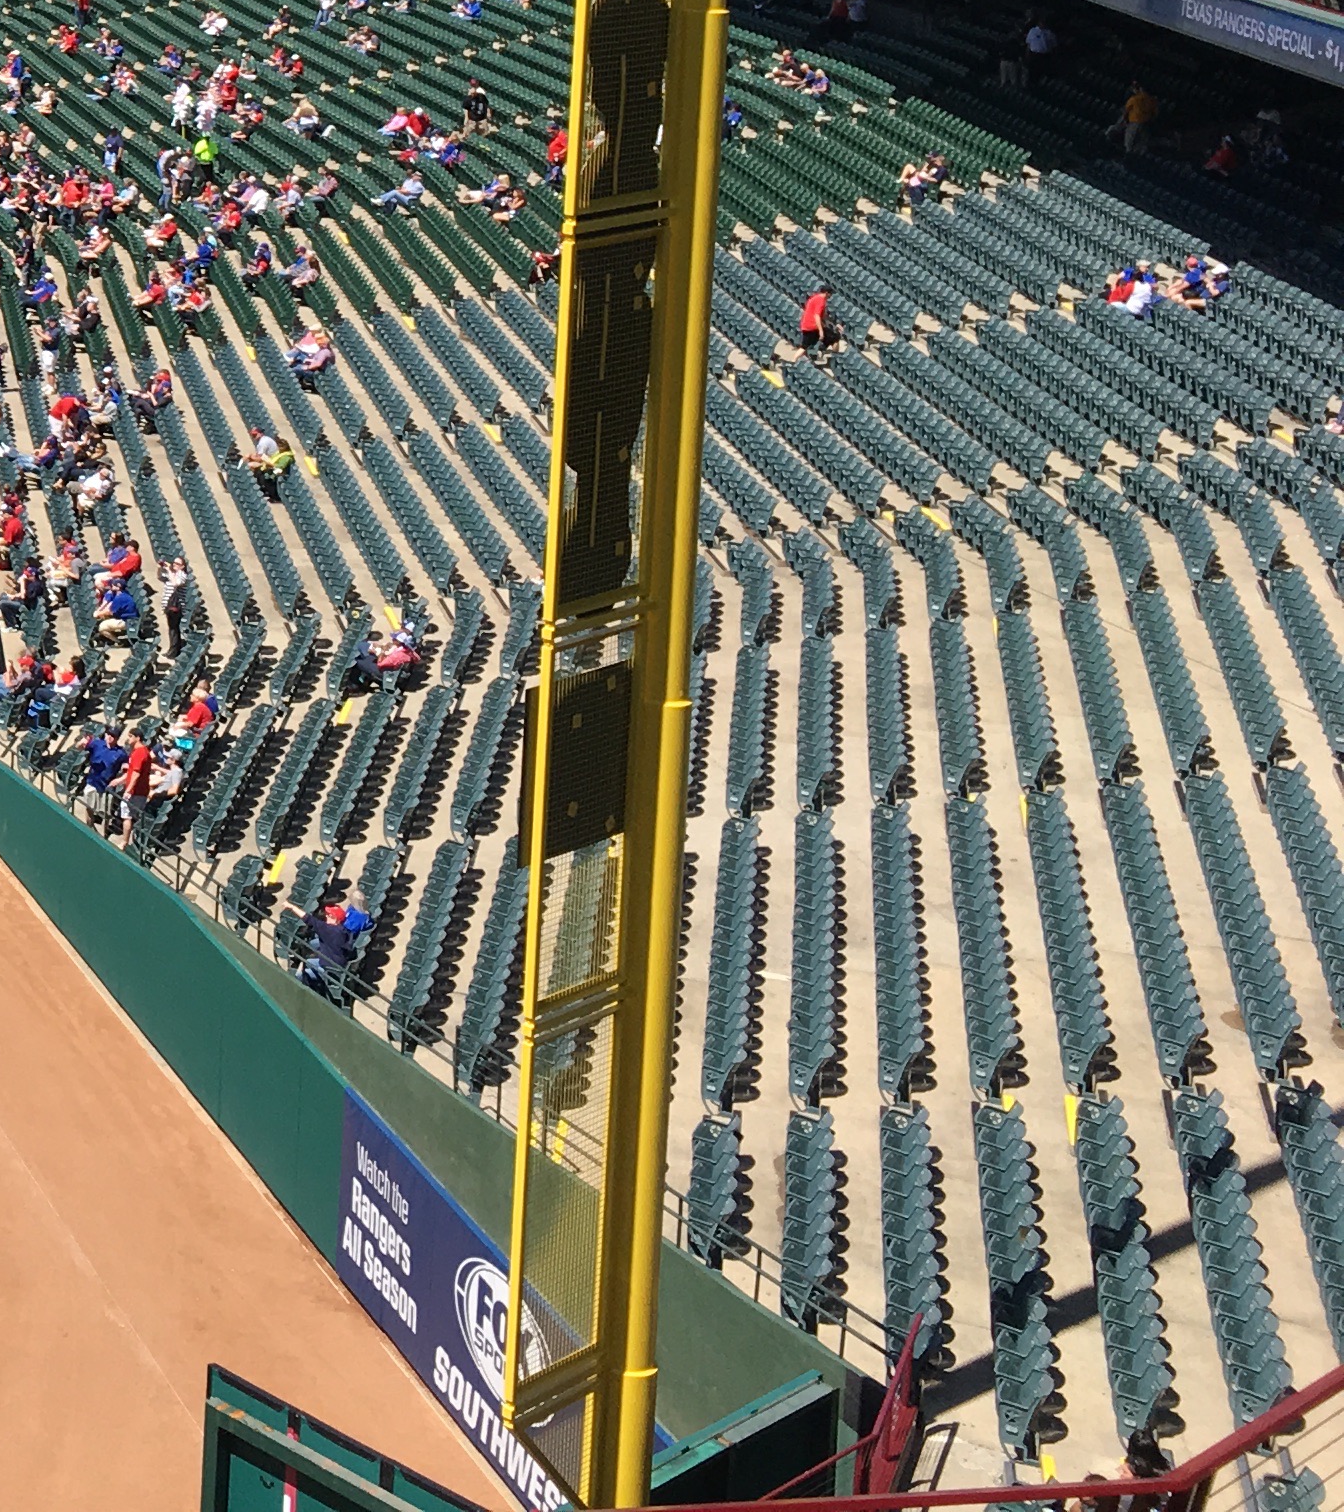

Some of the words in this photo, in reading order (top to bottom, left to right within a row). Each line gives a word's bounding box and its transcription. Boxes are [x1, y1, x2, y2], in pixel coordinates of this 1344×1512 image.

[1213, 7, 1265, 43] RANGERS
[1266, 24, 1314, 60] SPECIAL
[1325, 39, 1344, 72] $1,
[356, 1141, 390, 1203] Watch
[391, 1185, 409, 1225] the
[352, 1176, 411, 1276] Rangers
[342, 1216, 362, 1268] All
[363, 1239, 418, 1335] Season
[474, 1325, 507, 1380] SPO
